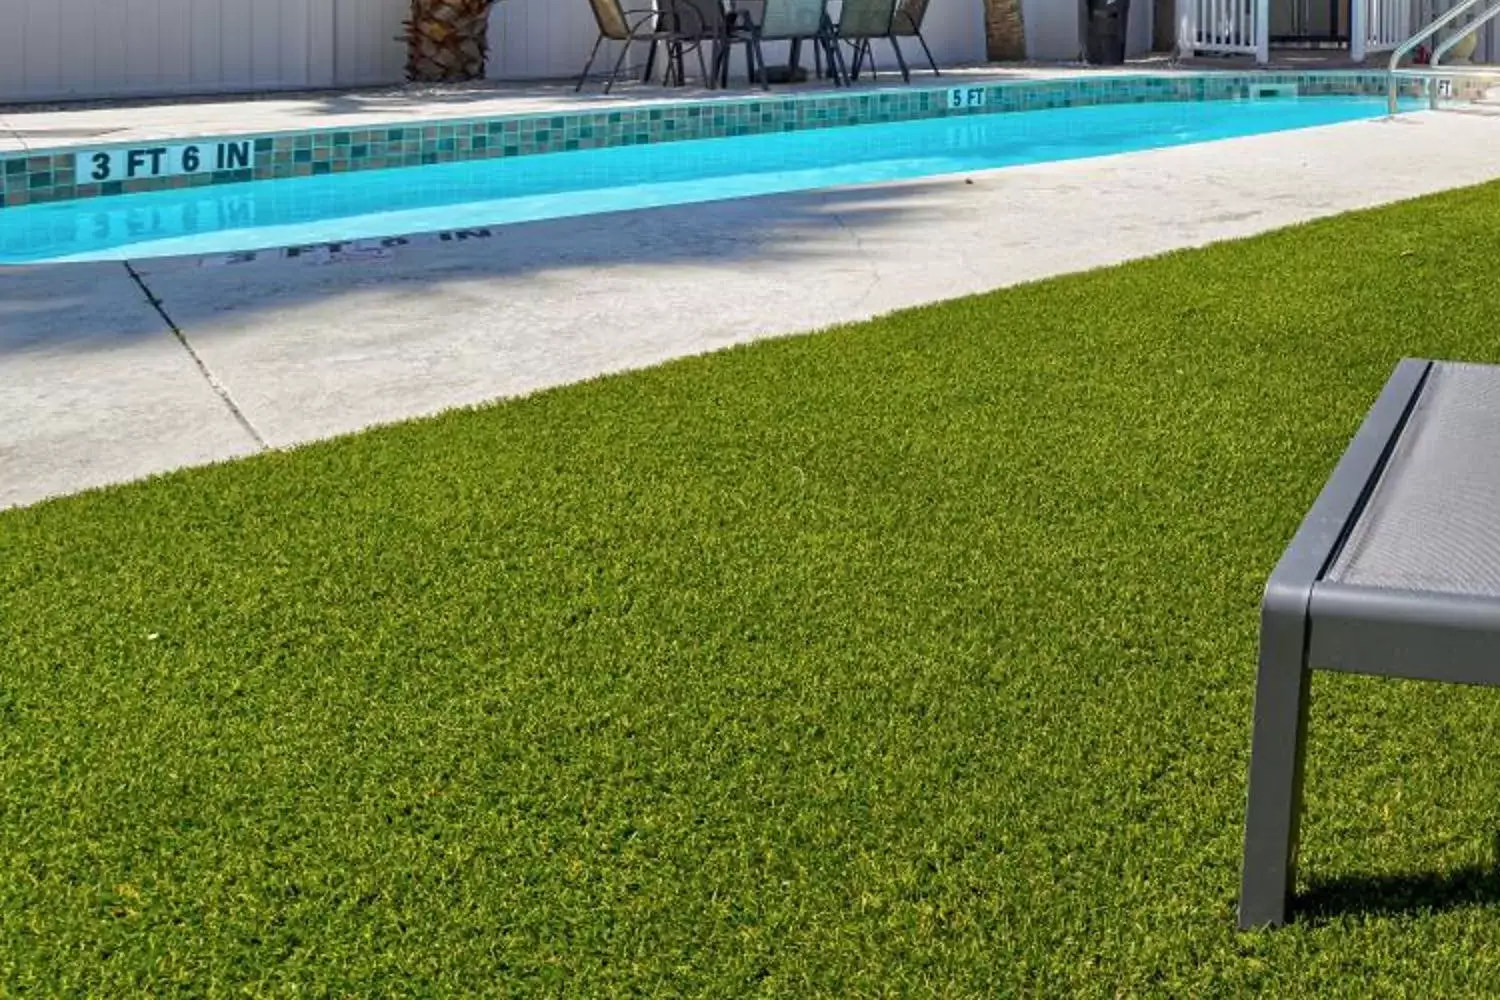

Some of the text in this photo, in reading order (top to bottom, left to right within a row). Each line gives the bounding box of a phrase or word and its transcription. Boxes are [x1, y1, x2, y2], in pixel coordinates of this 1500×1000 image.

[953, 87, 985, 106] 5 FT
[91, 142, 249, 180] 3 FT 6 IN
